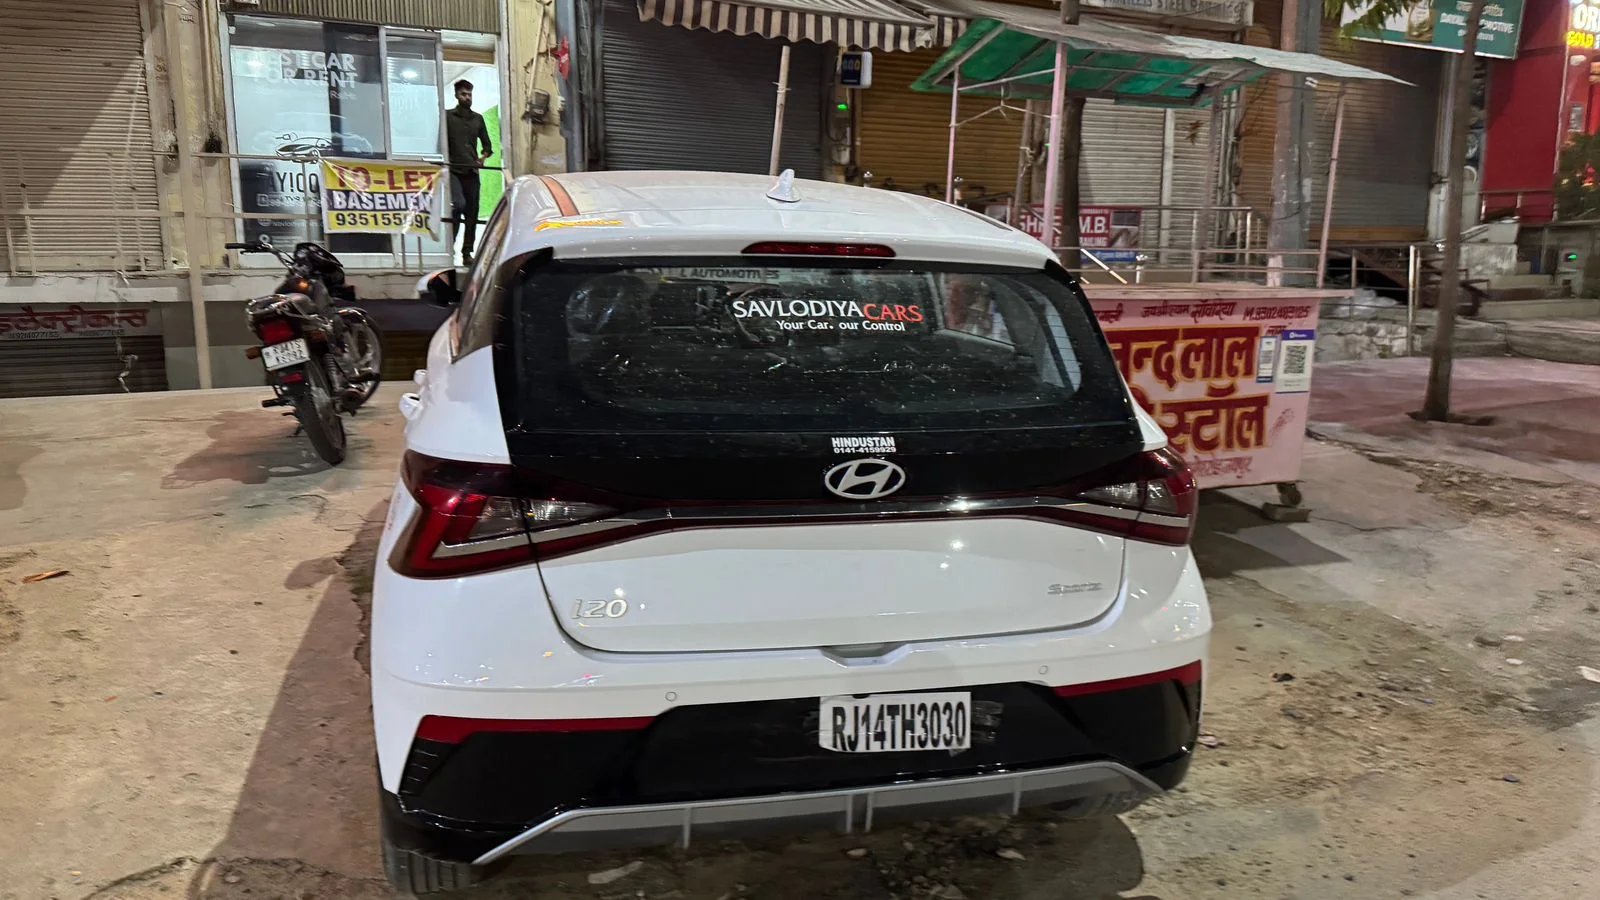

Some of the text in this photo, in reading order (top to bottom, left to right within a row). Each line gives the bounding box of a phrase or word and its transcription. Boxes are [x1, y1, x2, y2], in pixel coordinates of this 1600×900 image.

[314, 53, 356, 71] CAR
[304, 69, 358, 88] RENT
[333, 166, 437, 191] TO-LET
[333, 191, 432, 212] BASEMEN
[777, 320, 804, 330] Your
[839, 322, 860, 330] our
[861, 320, 906, 332] Control
[831, 436, 896, 447] HINDUSTAN
[832, 701, 967, 752] RJ14TH3030
